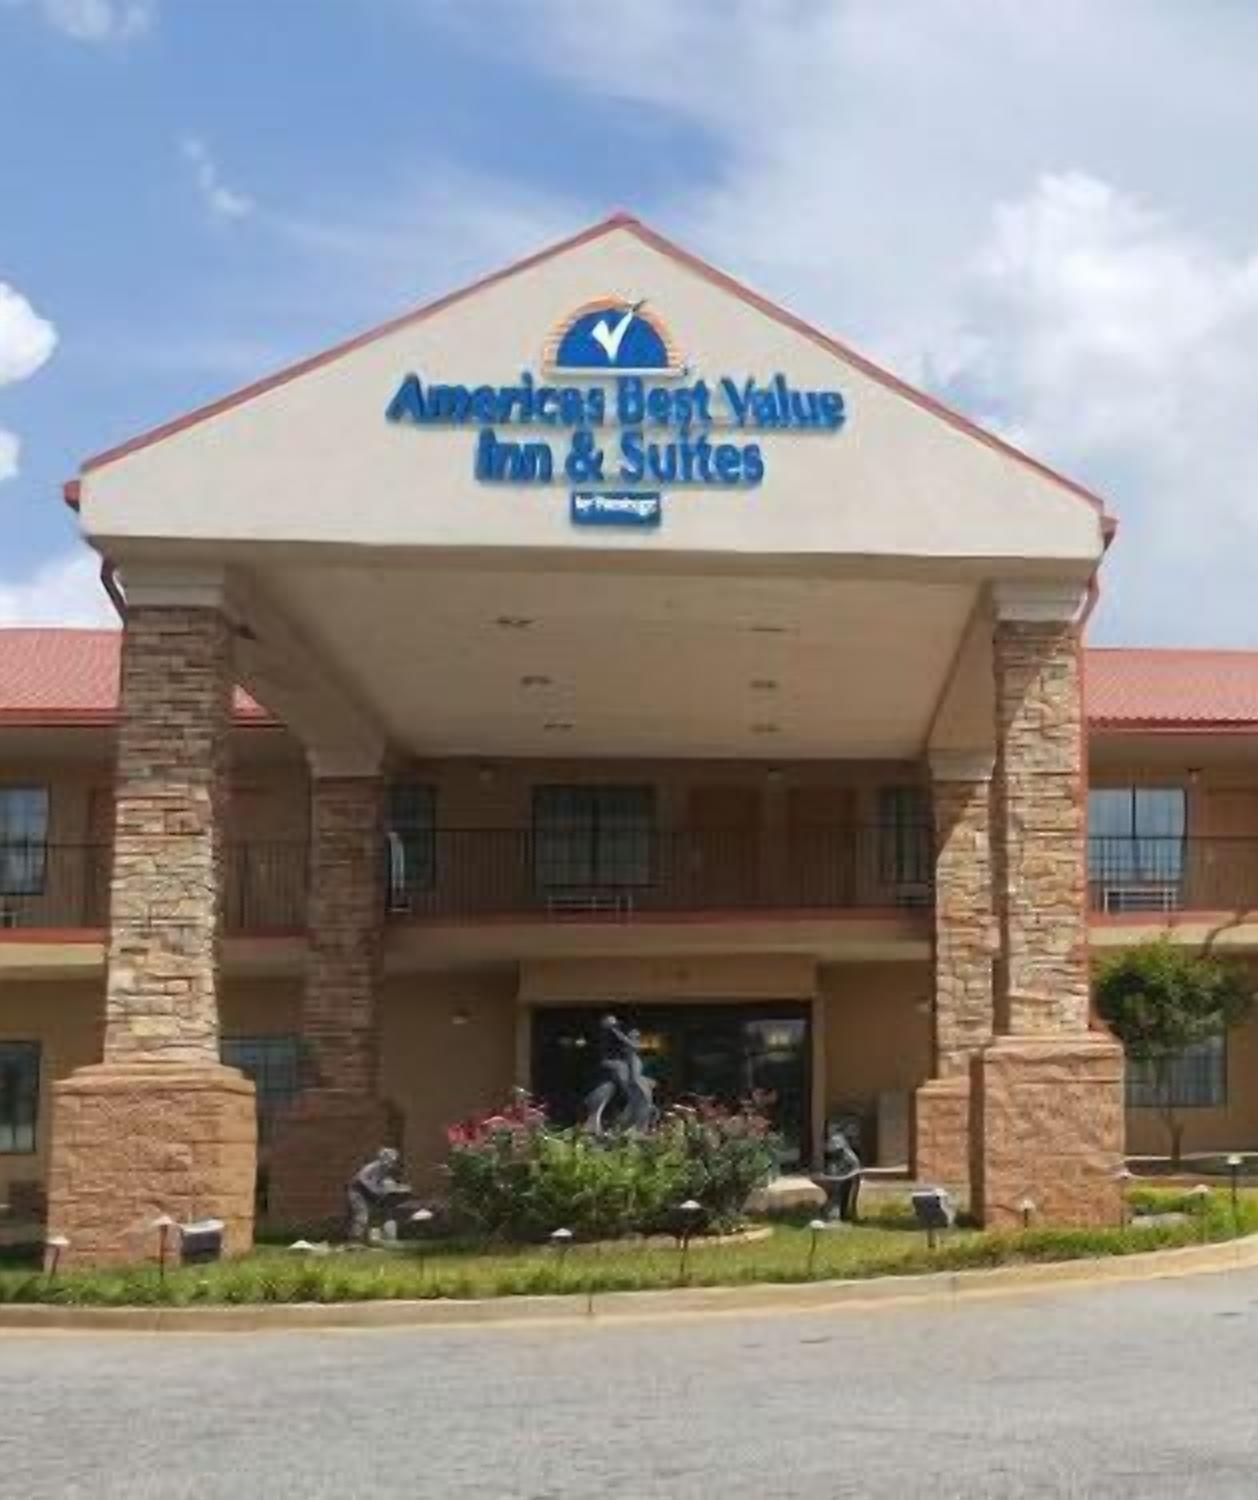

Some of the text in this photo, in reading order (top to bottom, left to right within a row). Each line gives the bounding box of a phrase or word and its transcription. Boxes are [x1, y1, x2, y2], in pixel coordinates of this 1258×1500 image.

[386, 372, 847, 430] Americas Best Value
[475, 425, 765, 485] Inn & Suites
